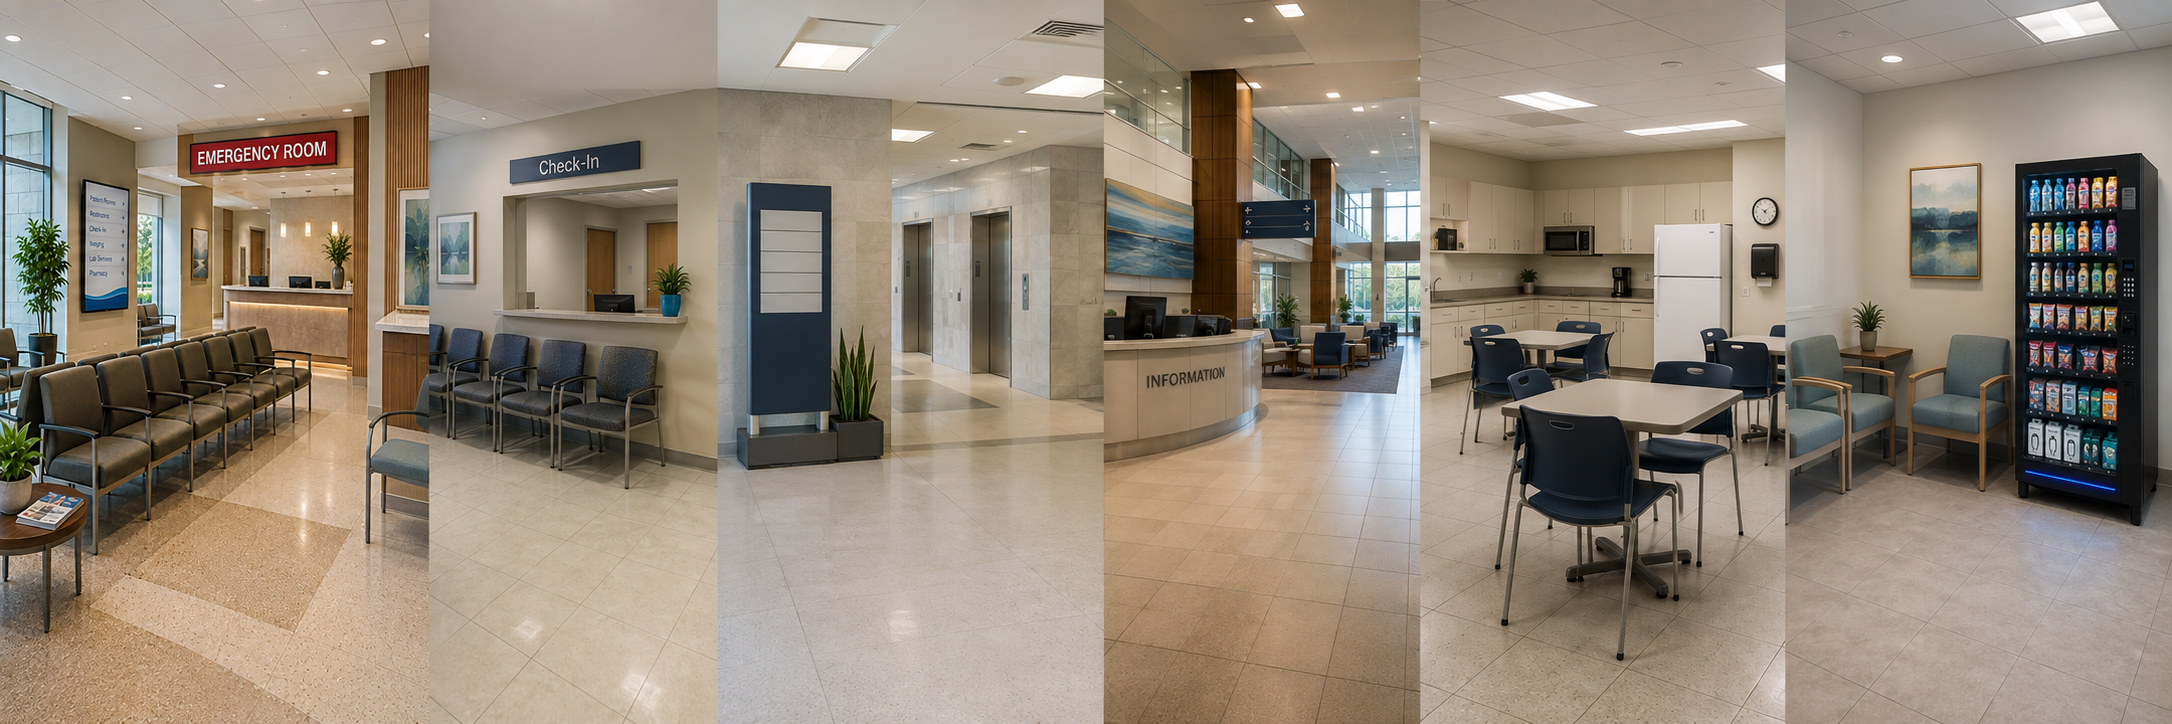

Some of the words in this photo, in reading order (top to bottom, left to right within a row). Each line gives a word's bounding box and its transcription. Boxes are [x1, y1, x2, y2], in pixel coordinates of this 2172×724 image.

[197, 144, 280, 166] EMERGENCY
[283, 140, 327, 159] ROOM
[539, 154, 599, 175] Check-In
[1146, 366, 1226, 389] INFORMATION
